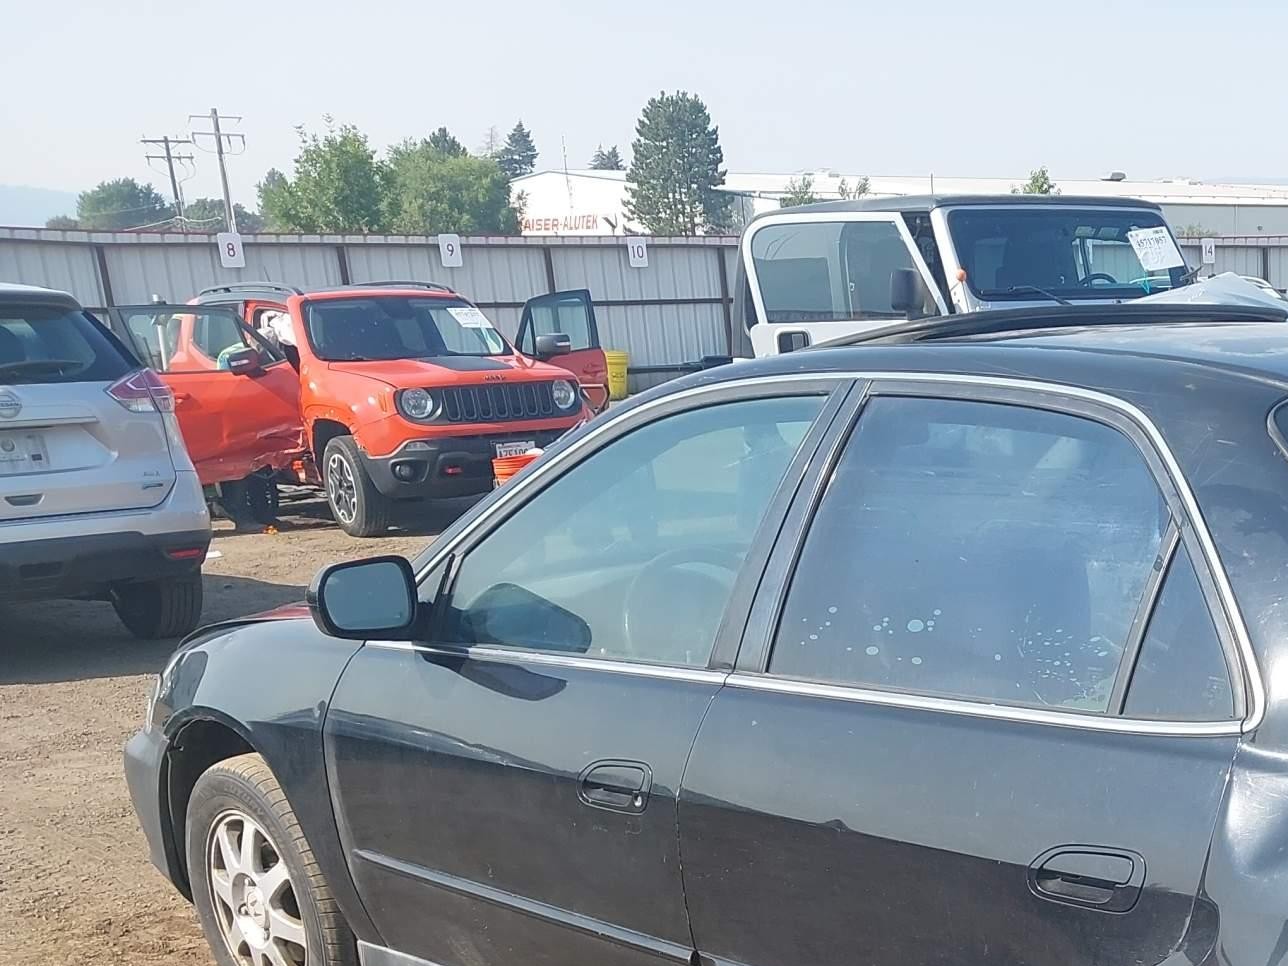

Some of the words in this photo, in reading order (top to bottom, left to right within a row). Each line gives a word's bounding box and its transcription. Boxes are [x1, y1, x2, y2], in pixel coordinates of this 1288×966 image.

[226, 242, 236, 257] 8
[446, 243, 455, 257] 9
[631, 245, 644, 259] 10
[1203, 245, 1213, 257] 14
